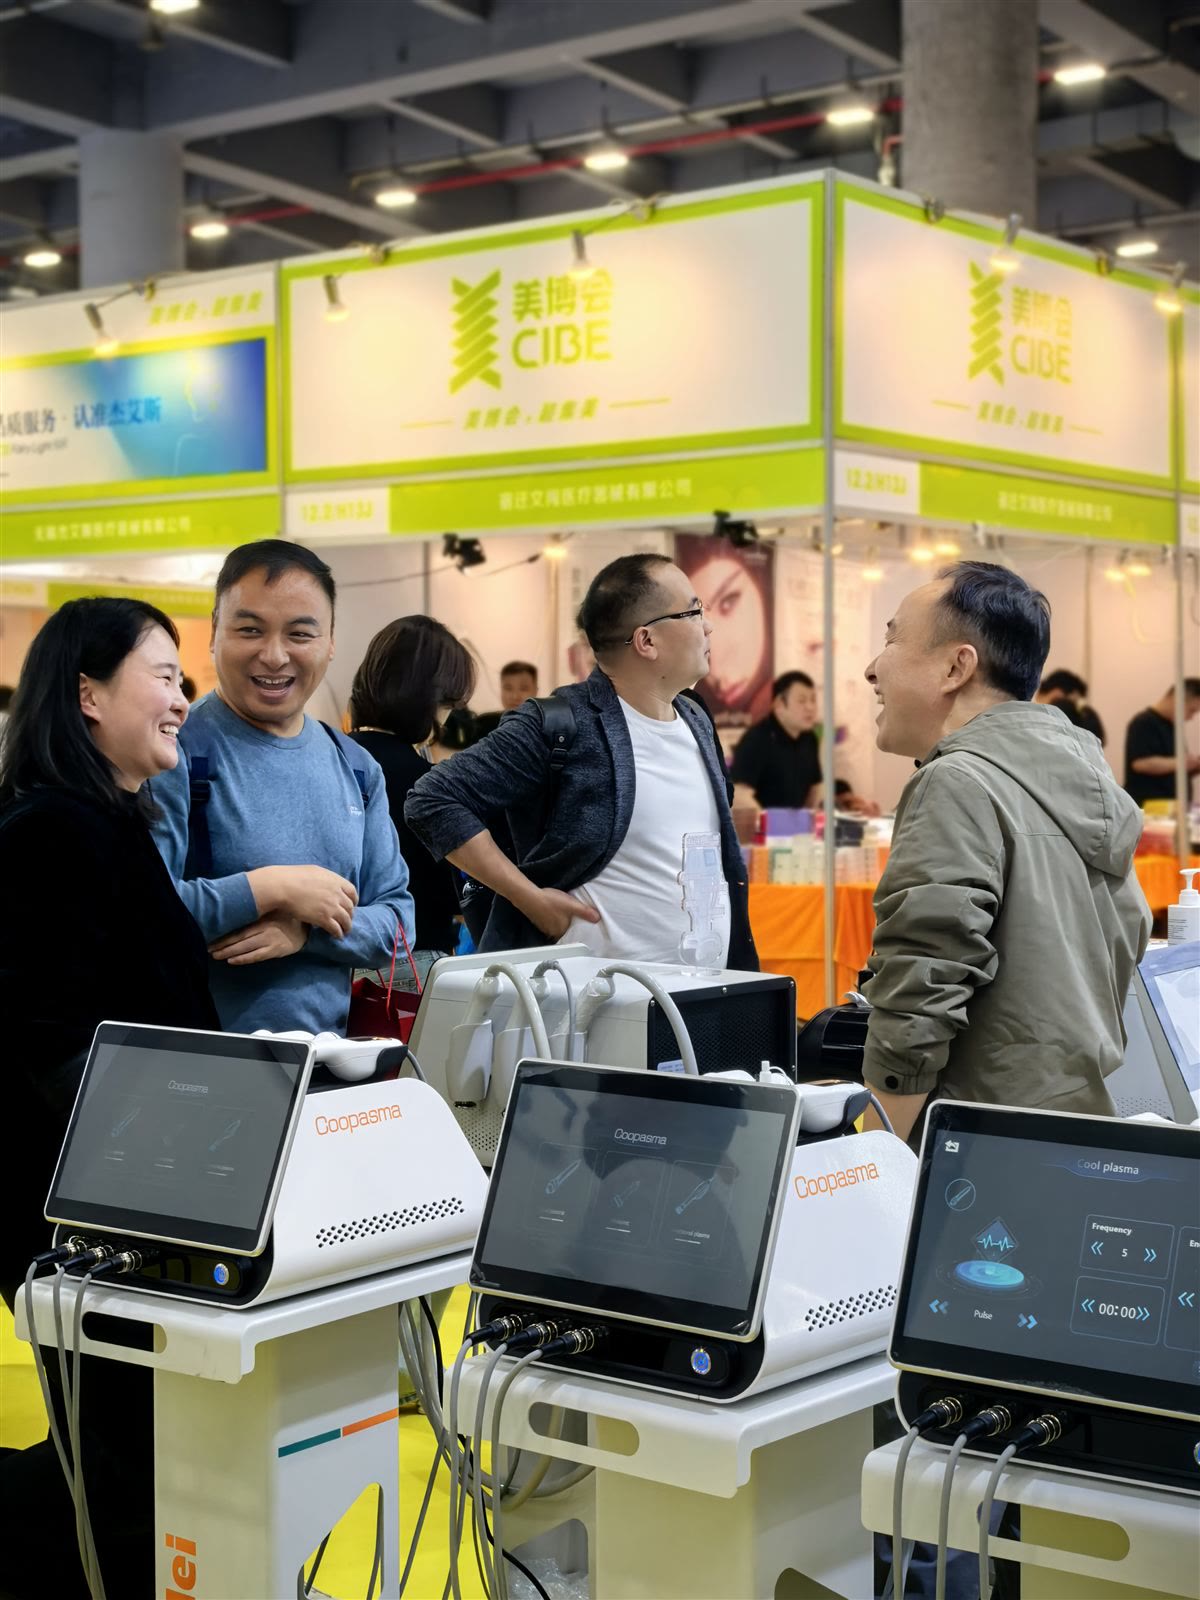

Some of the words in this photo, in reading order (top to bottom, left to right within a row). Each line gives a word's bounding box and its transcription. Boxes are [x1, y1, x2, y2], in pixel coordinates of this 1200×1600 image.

[512, 269, 612, 322] 美博会
[511, 320, 612, 369] CIBE
[1009, 334, 1073, 385] CIBE
[168, 1079, 209, 1094] Coopasma
[314, 1104, 402, 1136] Coopasma
[614, 1128, 668, 1145] Coopasma
[1077, 1158, 1101, 1172] Cool
[1102, 1162, 1140, 1176] plasma
[794, 1162, 879, 1199] Coopasma
[1091, 1222, 1132, 1236] Frequency
[1121, 1248, 1128, 1258] 5
[973, 1308, 993, 1320] Pulse
[1098, 1304, 1137, 1320] 00:00
